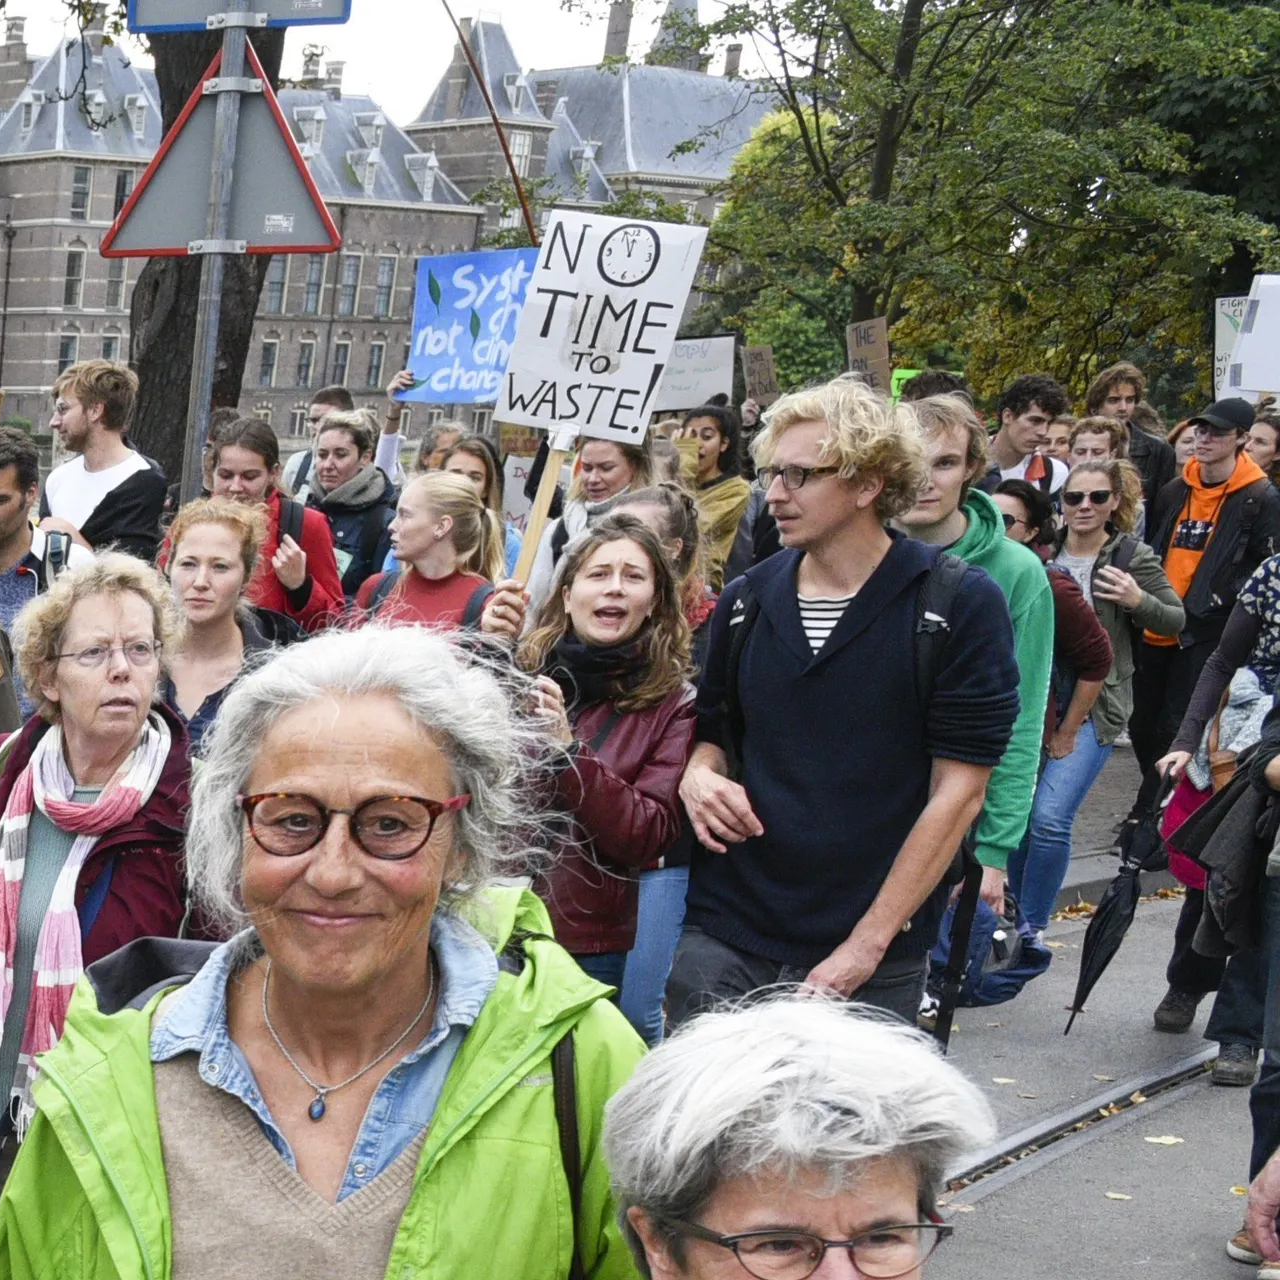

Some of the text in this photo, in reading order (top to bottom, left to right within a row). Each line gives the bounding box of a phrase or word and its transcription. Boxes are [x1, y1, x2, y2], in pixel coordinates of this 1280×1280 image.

[452, 260, 531, 309] Syst
[414, 319, 464, 356] not
[537, 287, 674, 354] TIME
[851, 325, 876, 348] THE
[430, 357, 504, 404] chang
[571, 351, 611, 374] TO
[508, 363, 665, 434] WASTE!
